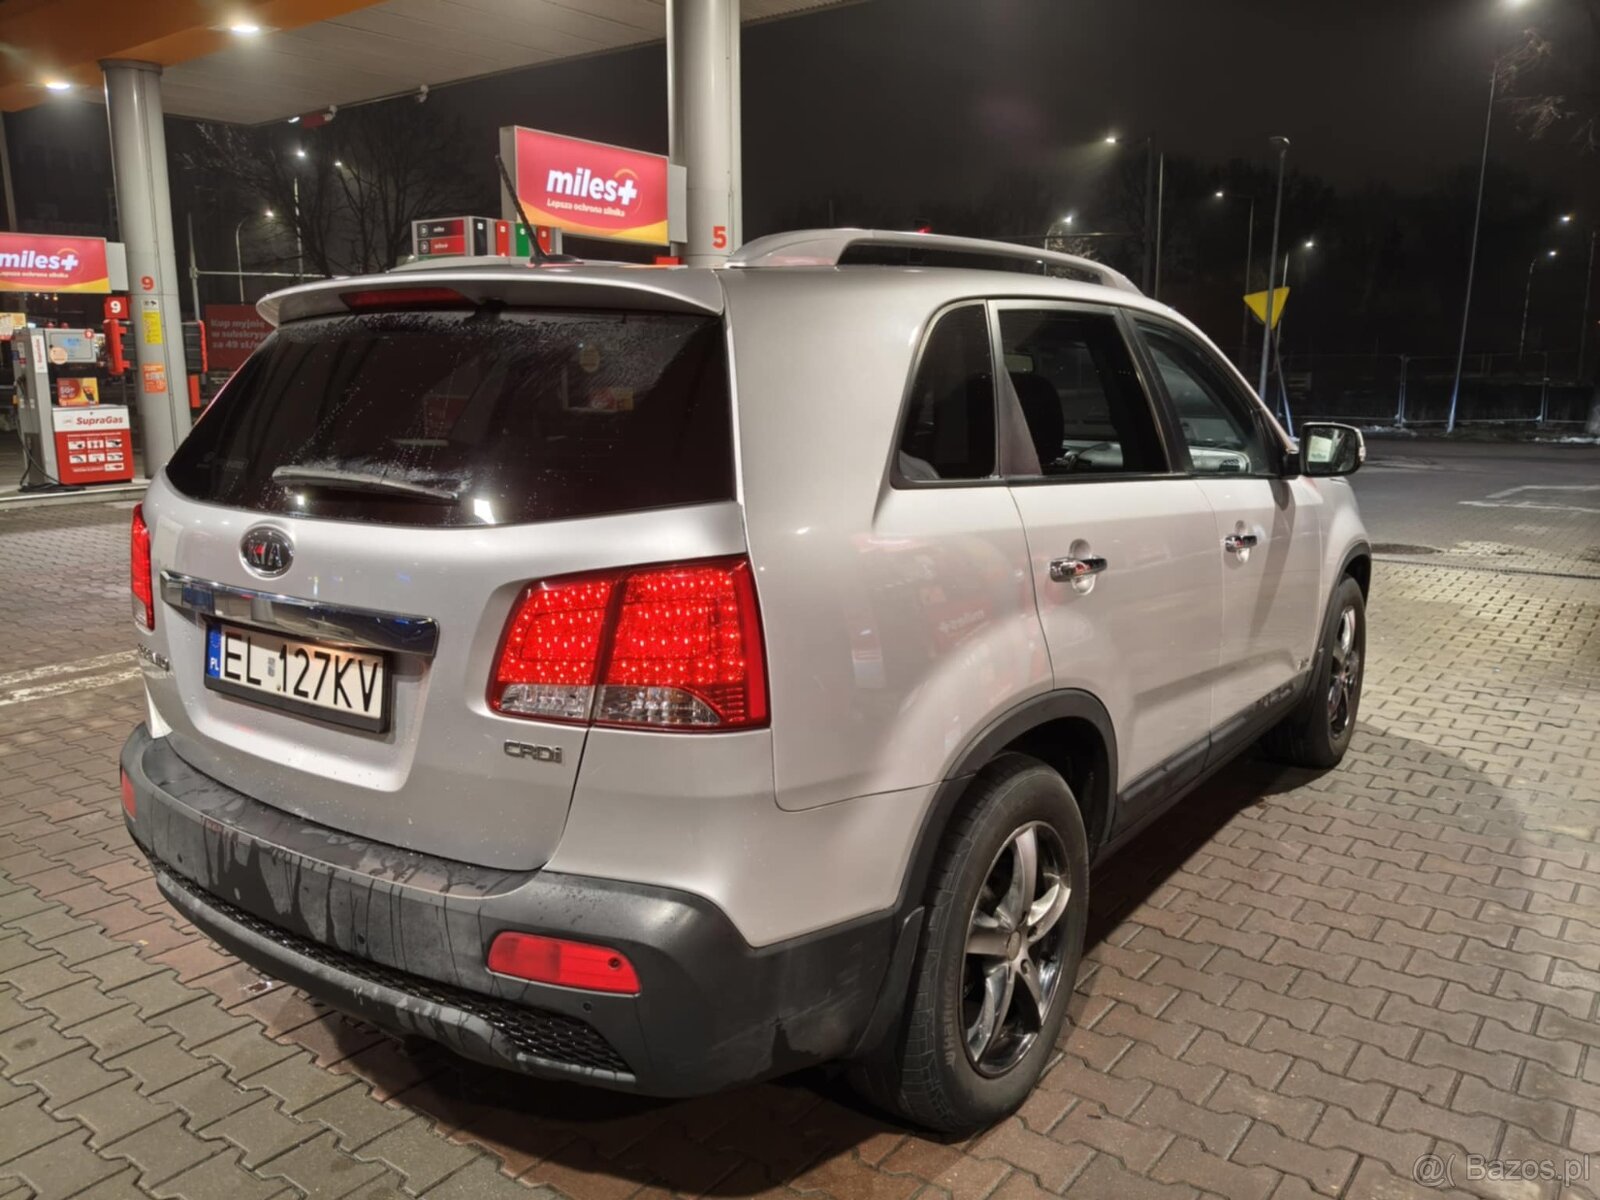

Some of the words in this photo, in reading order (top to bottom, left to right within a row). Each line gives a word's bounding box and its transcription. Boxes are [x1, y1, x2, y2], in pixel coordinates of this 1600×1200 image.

[546, 167, 638, 206] miles+
[573, 202, 603, 214] ochrona
[713, 225, 727, 249] 5
[0, 250, 79, 271] miles+
[141, 276, 155, 291] 9
[110, 300, 122, 314] 9
[76, 416, 123, 427] SupraGas
[250, 540, 282, 567] KIA
[210, 657, 219, 671] PL
[224, 632, 262, 686] EL
[279, 644, 379, 712] 127KV
